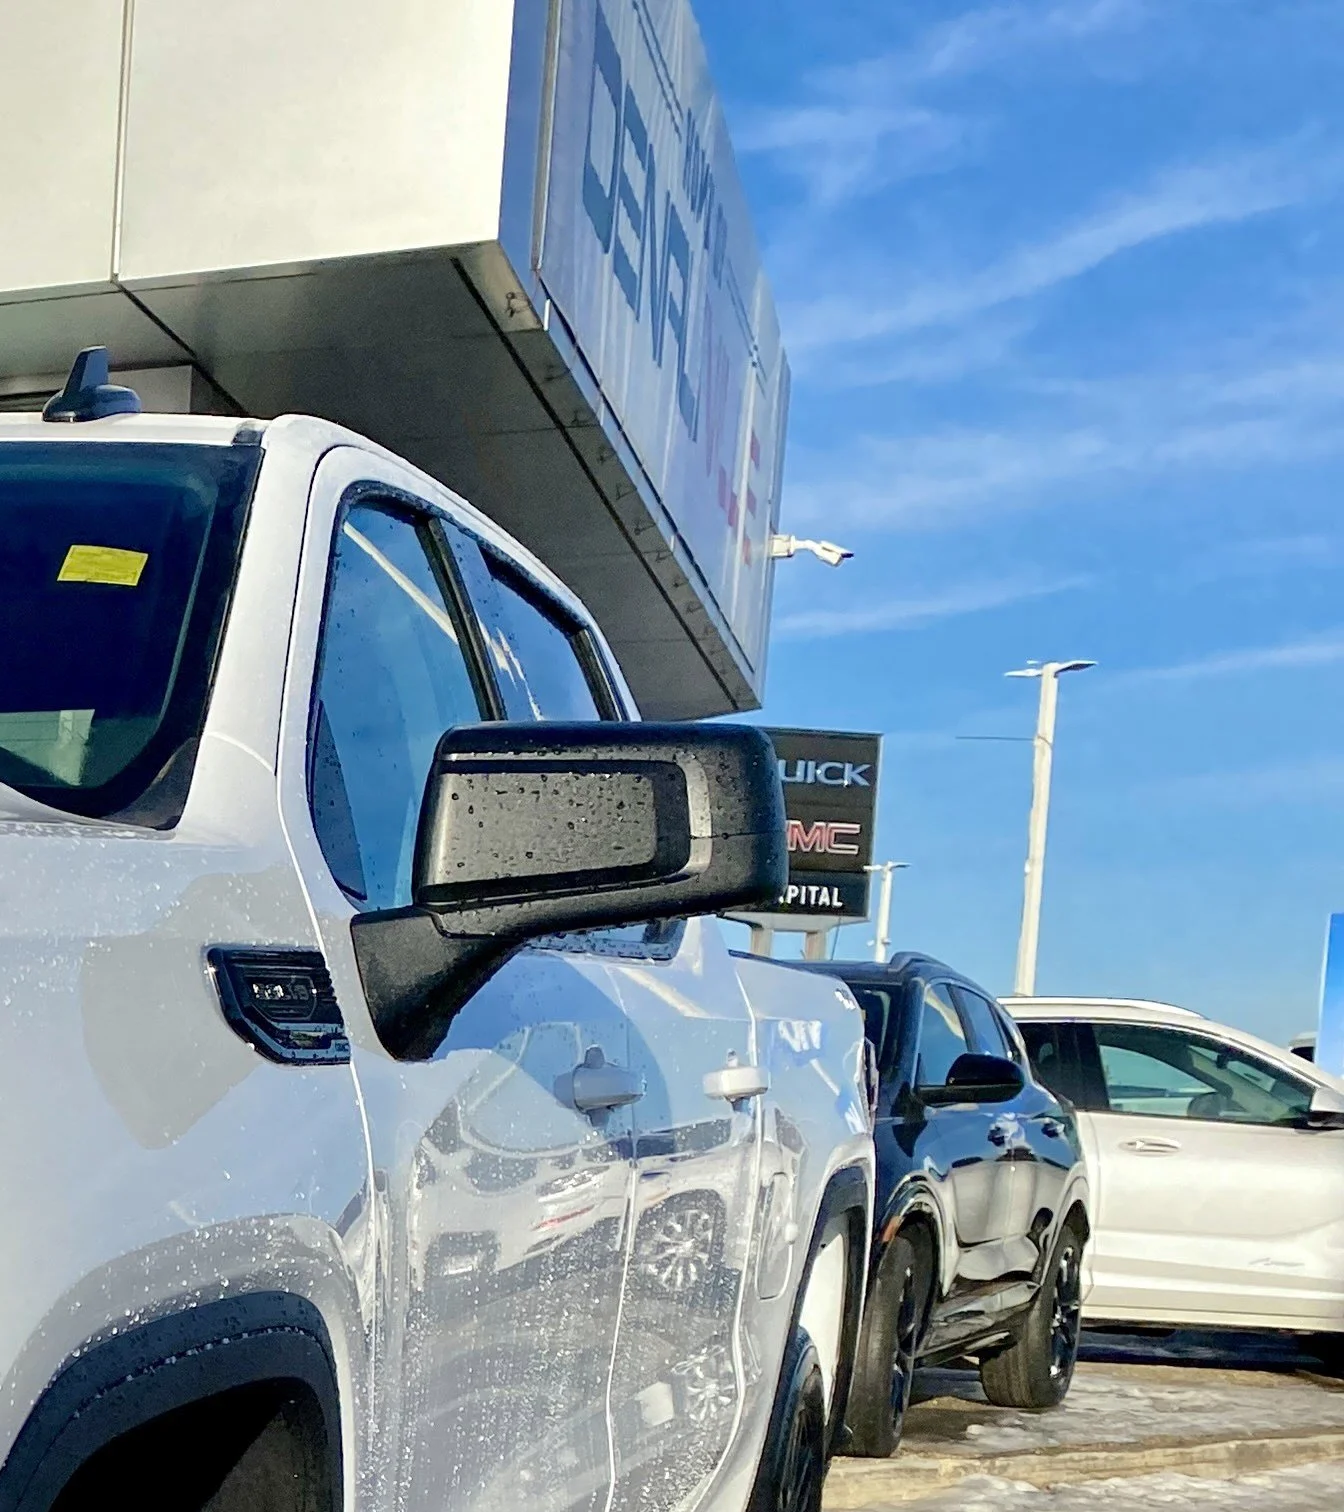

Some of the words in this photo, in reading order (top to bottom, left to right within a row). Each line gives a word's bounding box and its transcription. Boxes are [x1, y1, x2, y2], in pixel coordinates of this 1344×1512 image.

[778, 758, 873, 788] UICK
[785, 818, 861, 856] MC
[779, 884, 843, 908] PITAL
